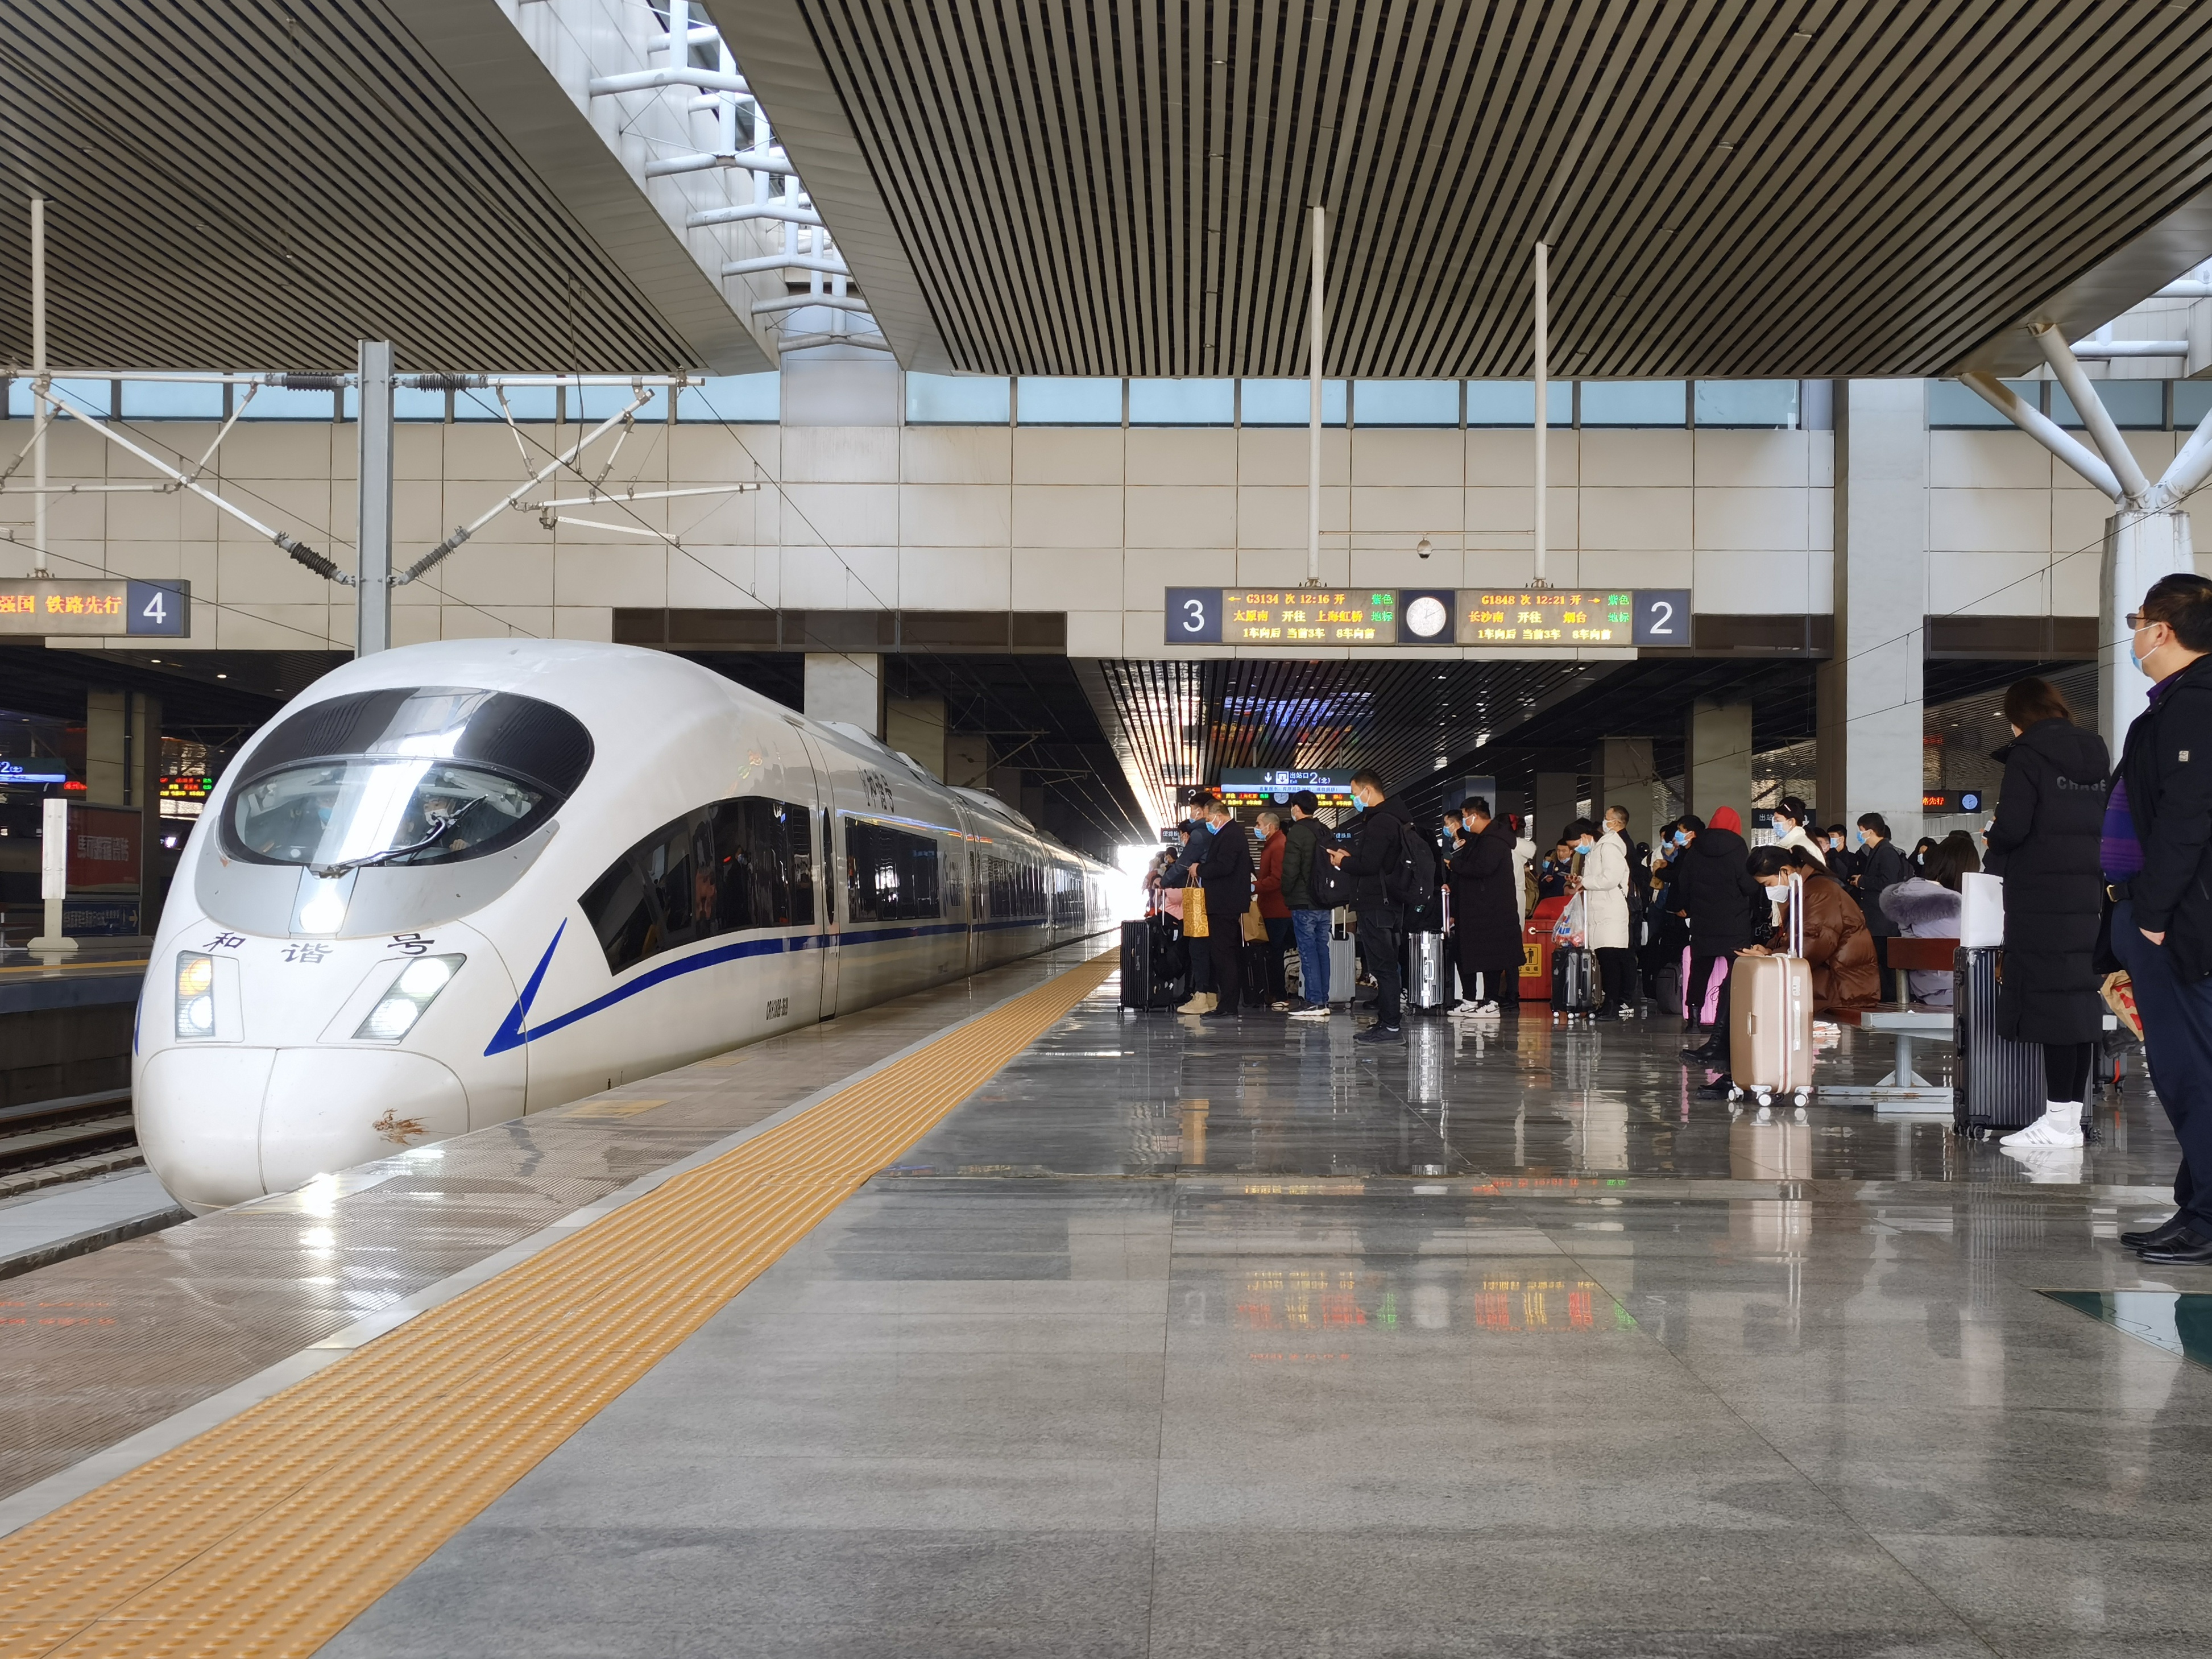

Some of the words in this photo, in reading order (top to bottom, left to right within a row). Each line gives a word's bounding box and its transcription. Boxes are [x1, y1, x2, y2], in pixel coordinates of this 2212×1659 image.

[45, 595, 123, 614] 铁路先行
[143, 592, 167, 624] 4
[1246, 594, 1278, 604] G3134
[1300, 594, 1329, 604] 12:16
[1333, 594, 1345, 605] 开
[1481, 595, 1515, 605] G1848
[1536, 595, 1565, 605] 12:21
[1569, 595, 1581, 606] 开
[1183, 599, 1204, 632] 3
[1233, 610, 1269, 622] 太原南
[1281, 610, 1306, 622] 开往
[1315, 610, 1364, 622] 上海虹桥
[1371, 610, 1393, 622] 地标
[1468, 611, 1504, 623] 长沙南
[1517, 611, 1543, 623] 开往
[1563, 611, 1587, 623] 烟台
[1608, 611, 1630, 623] 地标
[1650, 602, 1672, 634] 2
[203, 932, 435, 963] 和谐号
